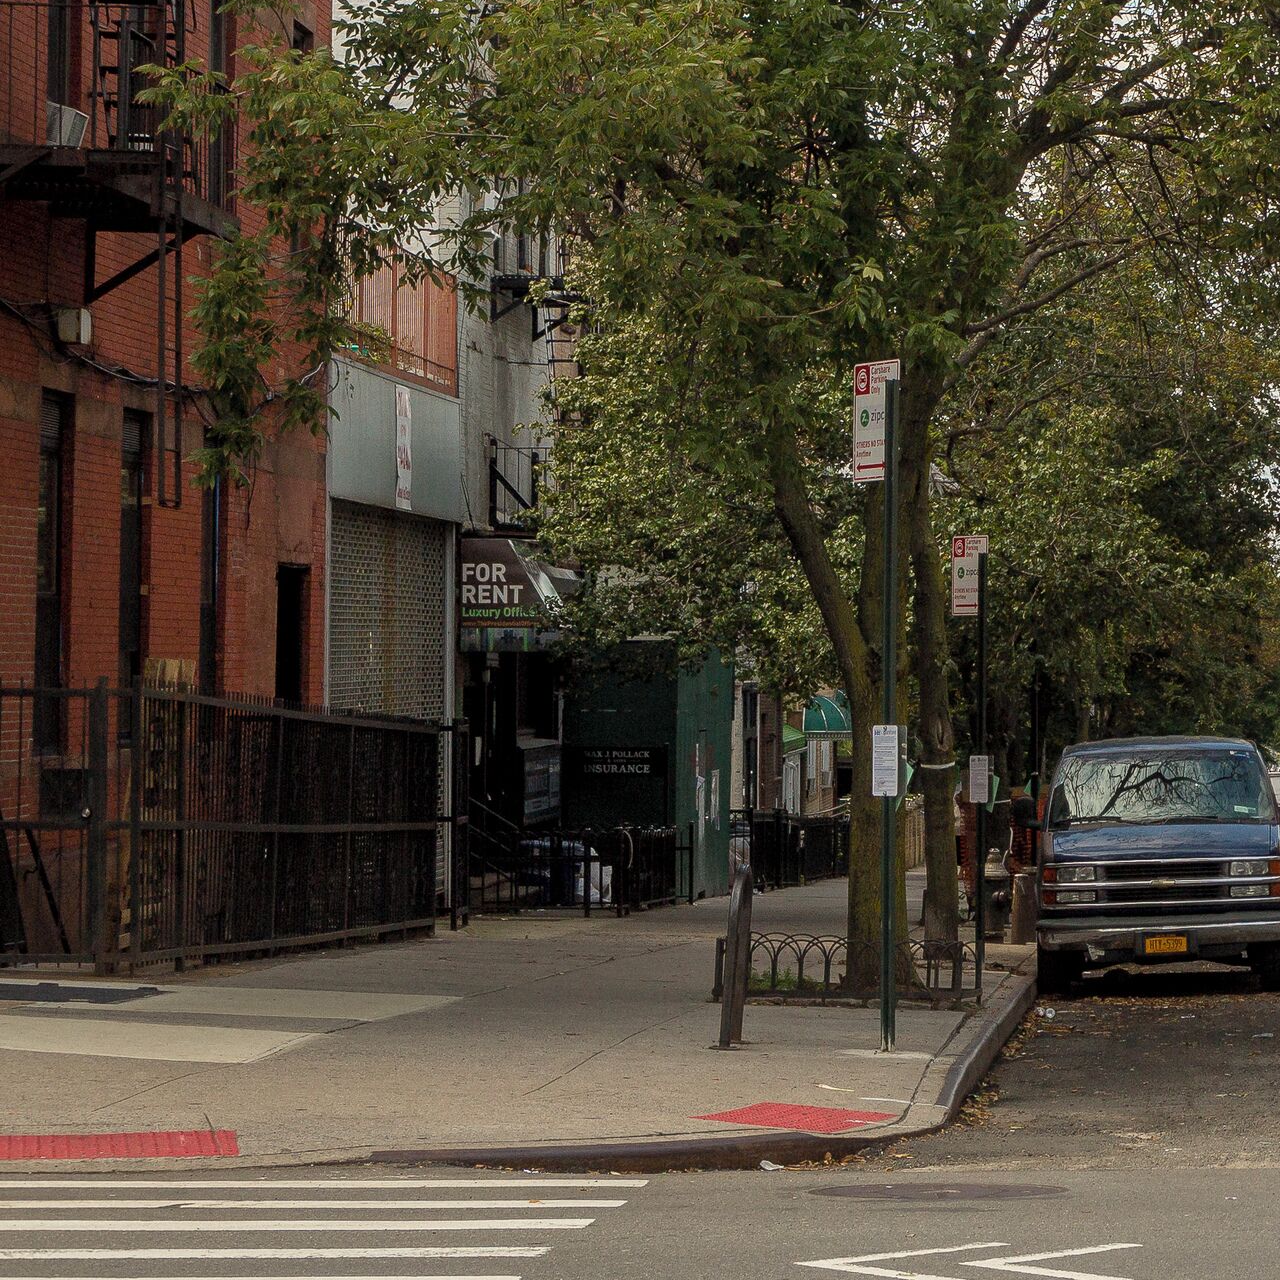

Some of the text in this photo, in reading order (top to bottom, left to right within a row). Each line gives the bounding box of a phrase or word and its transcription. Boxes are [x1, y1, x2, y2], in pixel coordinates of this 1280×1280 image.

[871, 365, 891, 375] Carshare
[871, 386, 881, 394] Only
[462, 563, 507, 582] FOR
[462, 585, 523, 604] RENT
[462, 607, 501, 619] Luxury
[584, 764, 650, 773] INSURANCE
